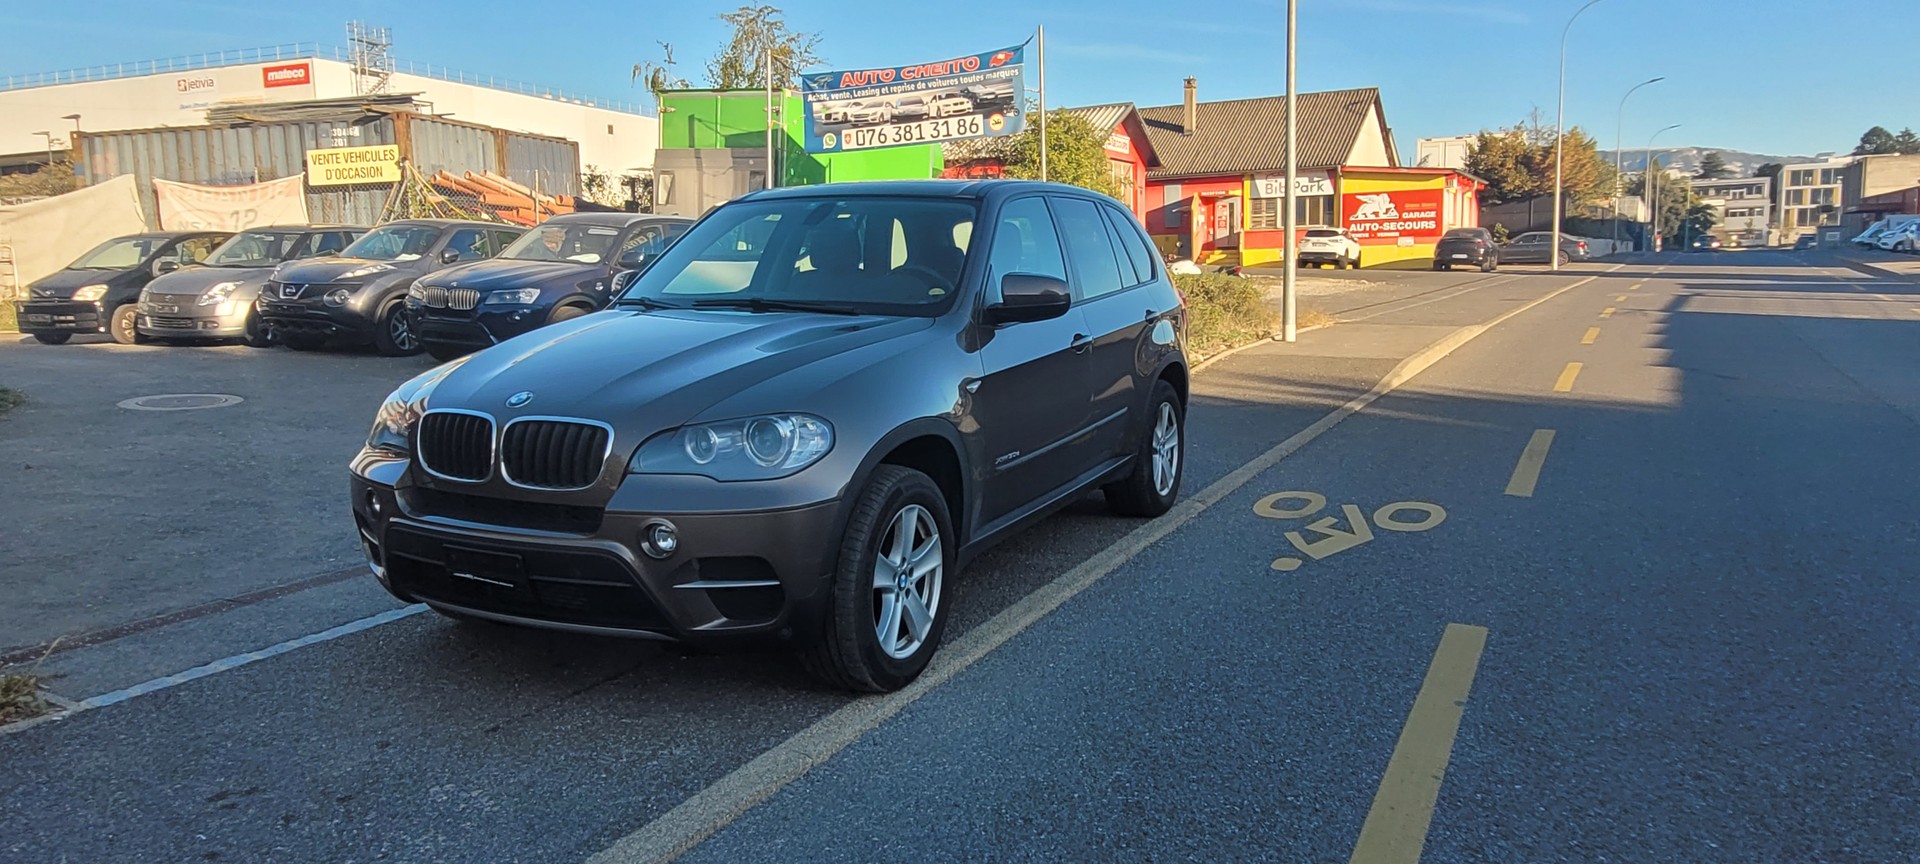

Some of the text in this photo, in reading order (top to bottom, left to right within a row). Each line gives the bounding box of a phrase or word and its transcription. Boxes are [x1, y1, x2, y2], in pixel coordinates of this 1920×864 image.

[267, 68, 305, 81] mateco
[840, 56, 980, 88] AUTO CHEITO
[187, 77, 215, 91] jetivia
[831, 91, 853, 100] vente,
[853, 87, 880, 98] Leasing
[881, 85, 889, 94] et
[891, 82, 915, 94] reprise
[917, 81, 926, 90] de
[928, 78, 959, 89] voitures
[960, 74, 984, 85] toutes
[986, 68, 1019, 80] marques
[855, 117, 980, 147] 076 381 31 86
[311, 149, 395, 165] VENTE VEHICULES
[325, 166, 383, 181] D'OCCASION
[1402, 211, 1437, 219] GARAGE
[1349, 220, 1437, 232] AUTO-SECOURS
